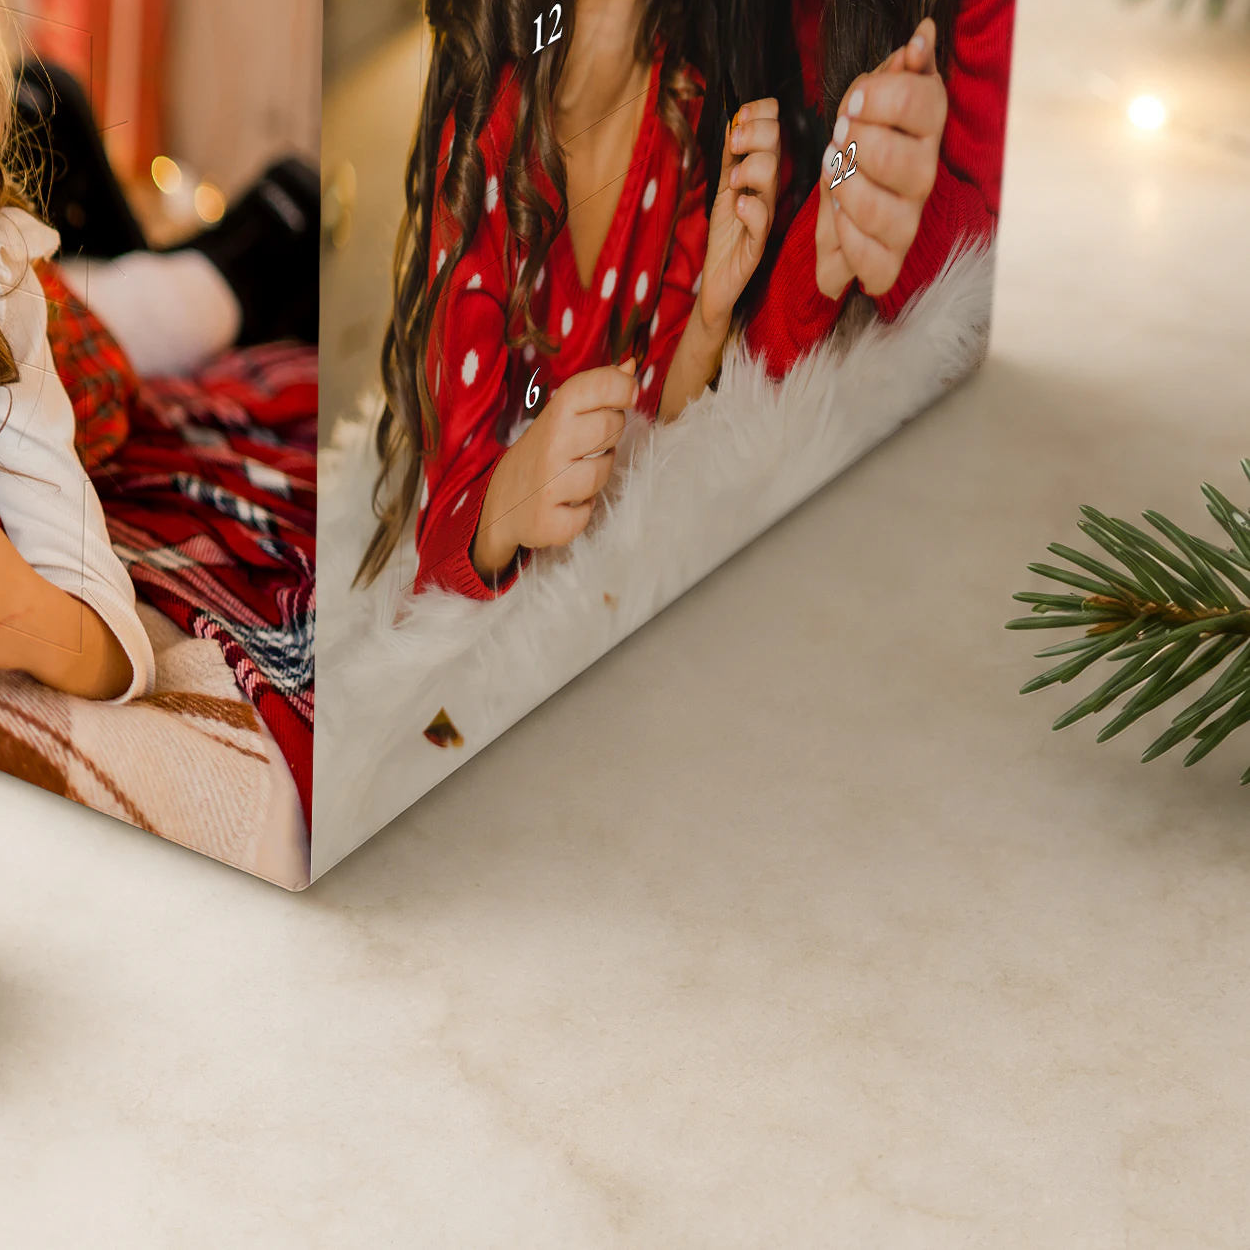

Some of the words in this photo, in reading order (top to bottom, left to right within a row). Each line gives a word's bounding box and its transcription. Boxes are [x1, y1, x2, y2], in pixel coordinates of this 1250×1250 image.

[532, 3, 564, 54] 12
[829, 141, 858, 191] 22
[524, 367, 540, 410] 6
